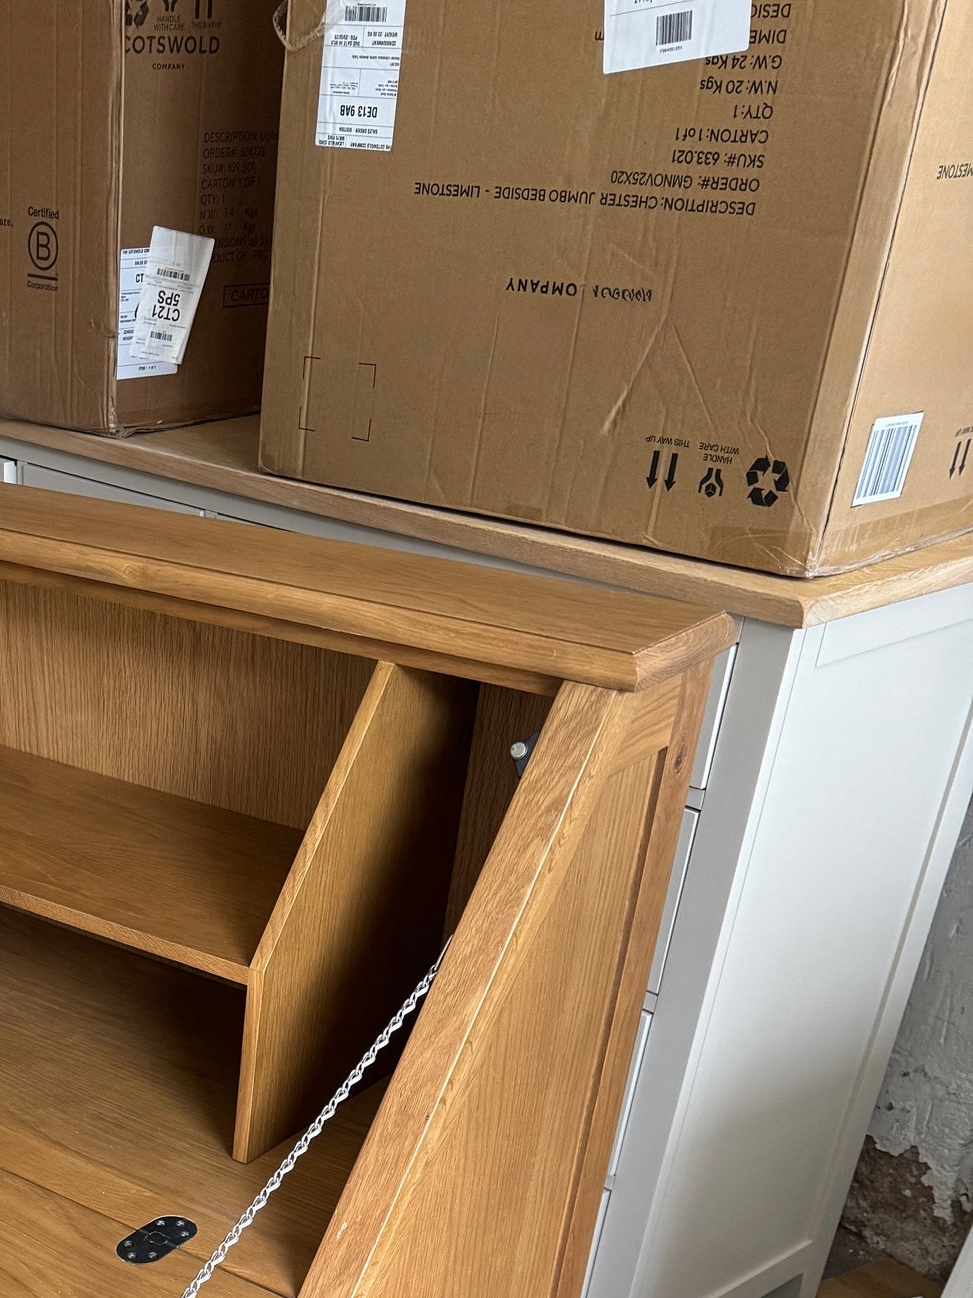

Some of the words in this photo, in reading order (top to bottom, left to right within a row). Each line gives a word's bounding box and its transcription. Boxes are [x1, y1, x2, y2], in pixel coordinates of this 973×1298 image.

[732, 54, 746, 70] 24
[750, 54, 782, 70] G.W:
[699, 75, 723, 94] Kgs
[725, 80, 744, 94] 20
[746, 80, 779, 96] N.W:
[732, 104, 738, 119] 1
[740, 102, 774, 120] QTY:
[675, 127, 680, 141] 1
[682, 127, 696, 142] of
[698, 128, 703, 142] 1
[705, 128, 769, 144] CARTON:
[671, 149, 720, 166] 633.021
[723, 153, 765, 169] SKU#:
[610, 170, 693, 190] GMNOV25X20
[697, 175, 760, 192] ORDER#:
[414, 182, 481, 198] LIMESTONE
[493, 186, 546, 202] BEDSIDE
[548, 189, 596, 205] JUMBO
[599, 192, 658, 210] CHESTER
[660, 196, 756, 216] DESCRIPTION:
[28, 206, 60, 220] Certified
[27, 280, 59, 292] Corporation
[506, 278, 577, 296] OMPANY
[158, 290, 180, 307] 5PS
[152, 304, 180, 322] CT21
[646, 435, 656, 443] UP
[656, 436, 673, 445] WAY
[674, 436, 690, 448] THIS
[698, 442, 719, 451] CARE
[702, 453, 733, 464] HANDLE
[720, 446, 740, 455] WITH
